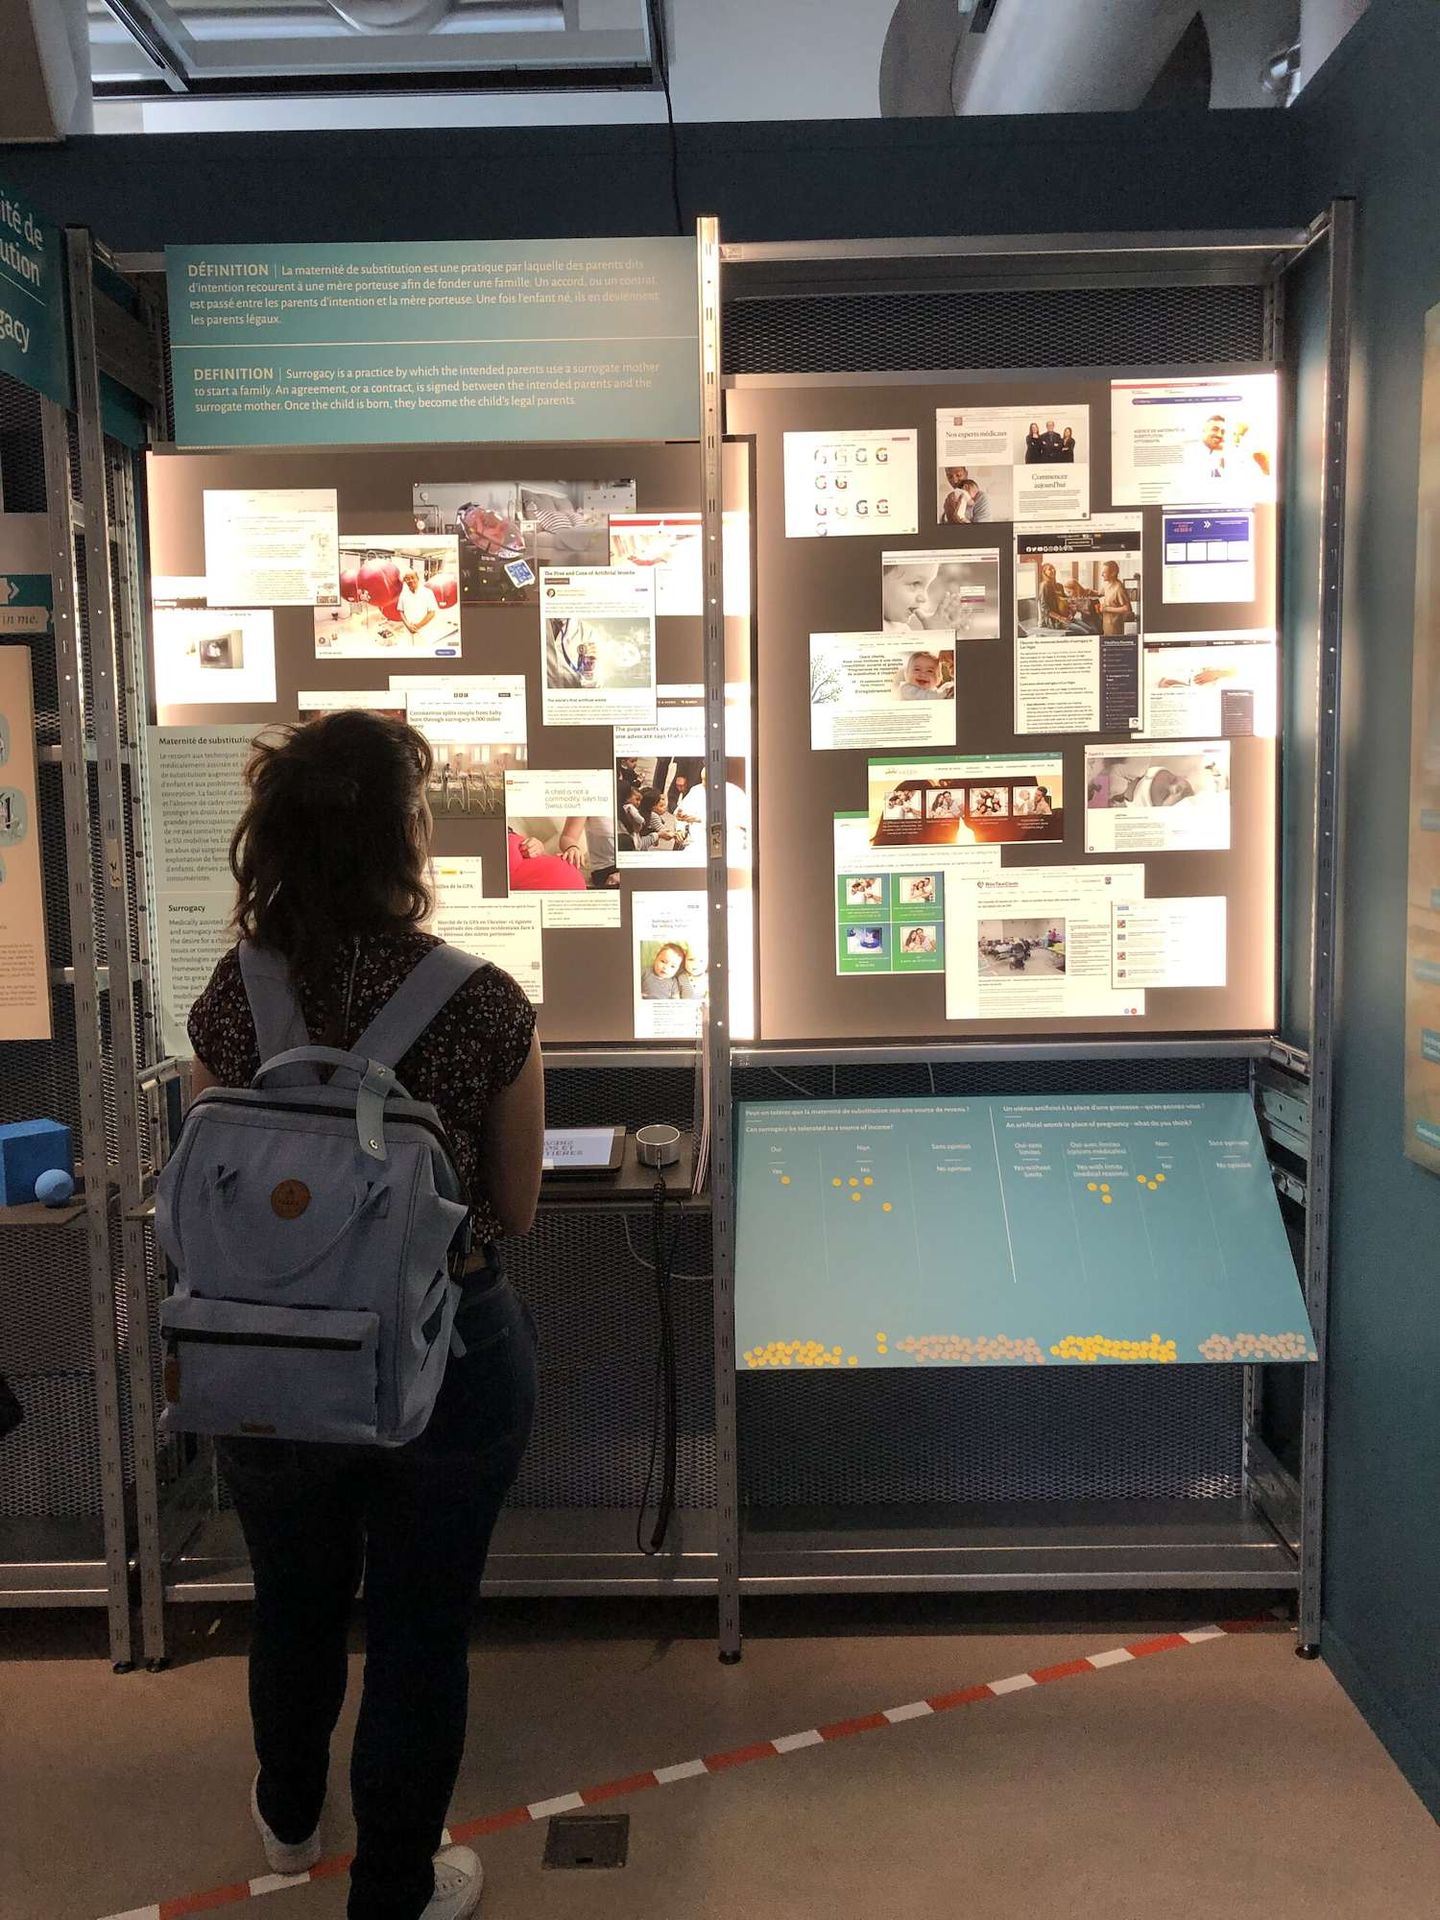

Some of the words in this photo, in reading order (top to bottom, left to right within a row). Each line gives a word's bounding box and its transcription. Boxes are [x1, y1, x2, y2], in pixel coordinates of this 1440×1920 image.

[25, 212, 43, 251] de
[188, 262, 268, 276] DÉFINITION
[281, 264, 293, 275] La
[294, 264, 344, 277] maternité
[346, 263, 359, 274] de
[360, 262, 421, 274] substitution
[422, 264, 438, 273] est
[440, 264, 459, 273] une
[461, 263, 504, 275] pratique
[505, 263, 523, 274] par
[524, 259, 564, 275] laquelle
[566, 259, 584, 270] des
[585, 260, 623, 273] parents
[188, 281, 244, 293] d'intention
[246, 282, 295, 292] recourent
[305, 283, 324, 291] une
[326, 280, 352, 290] mère
[355, 281, 400, 292] porteuse
[401, 278, 420, 289] afin
[422, 278, 436, 291] de
[437, 277, 472, 289] fonder
[473, 280, 492, 289] une
[494, 276, 531, 291] famille.
[533, 276, 549, 287] Un
[549, 275, 588, 287] accord,
[589, 278, 602, 286] ou
[604, 277, 617, 286] un
[189, 300, 205, 309] est
[206, 297, 234, 310] passé
[235, 299, 262, 308] entre
[264, 297, 278, 308] les
[280, 298, 318, 310] parents
[320, 295, 374, 307] d'intention
[376, 293, 387, 305] et
[388, 294, 398, 305] la
[400, 294, 426, 306] mère
[476, 290, 496, 304] Une
[498, 292, 516, 304] fois
[518, 291, 556, 303] l'enfant
[574, 291, 586, 302] ils
[587, 294, 600, 304] en
[190, 314, 204, 325] les
[206, 315, 244, 326] parents
[194, 367, 273, 380] DEFINITION
[286, 367, 335, 381] Surrogacy
[354, 367, 394, 379] practice
[395, 366, 407, 379] by
[408, 365, 439, 376] which
[441, 364, 458, 376] the
[459, 364, 504, 375] intended
[506, 365, 544, 376] parents
[544, 364, 563, 377] use
[572, 361, 620, 377] surrogate
[622, 360, 660, 376] mother
[194, 388, 205, 396] to
[206, 387, 230, 396] start
[275, 384, 289, 394] An
[291, 385, 348, 396] agreement,
[350, 385, 361, 393] or
[425, 380, 460, 394] signed
[462, 379, 505, 391] between
[507, 378, 524, 390] the
[526, 376, 572, 392] intended
[573, 378, 612, 392] parents
[613, 376, 634, 390] and
[635, 375, 652, 388] the
[195, 402, 242, 414] surrogate
[284, 400, 310, 410] Once
[311, 398, 328, 410] the
[330, 398, 354, 409] child
[366, 397, 392, 409] born,
[394, 397, 416, 410] they
[418, 396, 458, 407] become
[459, 395, 476, 406] the
[477, 394, 509, 406] child's
[511, 394, 535, 407] legal
[158, 737, 196, 745] Maternité
[197, 736, 207, 744] de
[208, 736, 251, 745] substitutio
